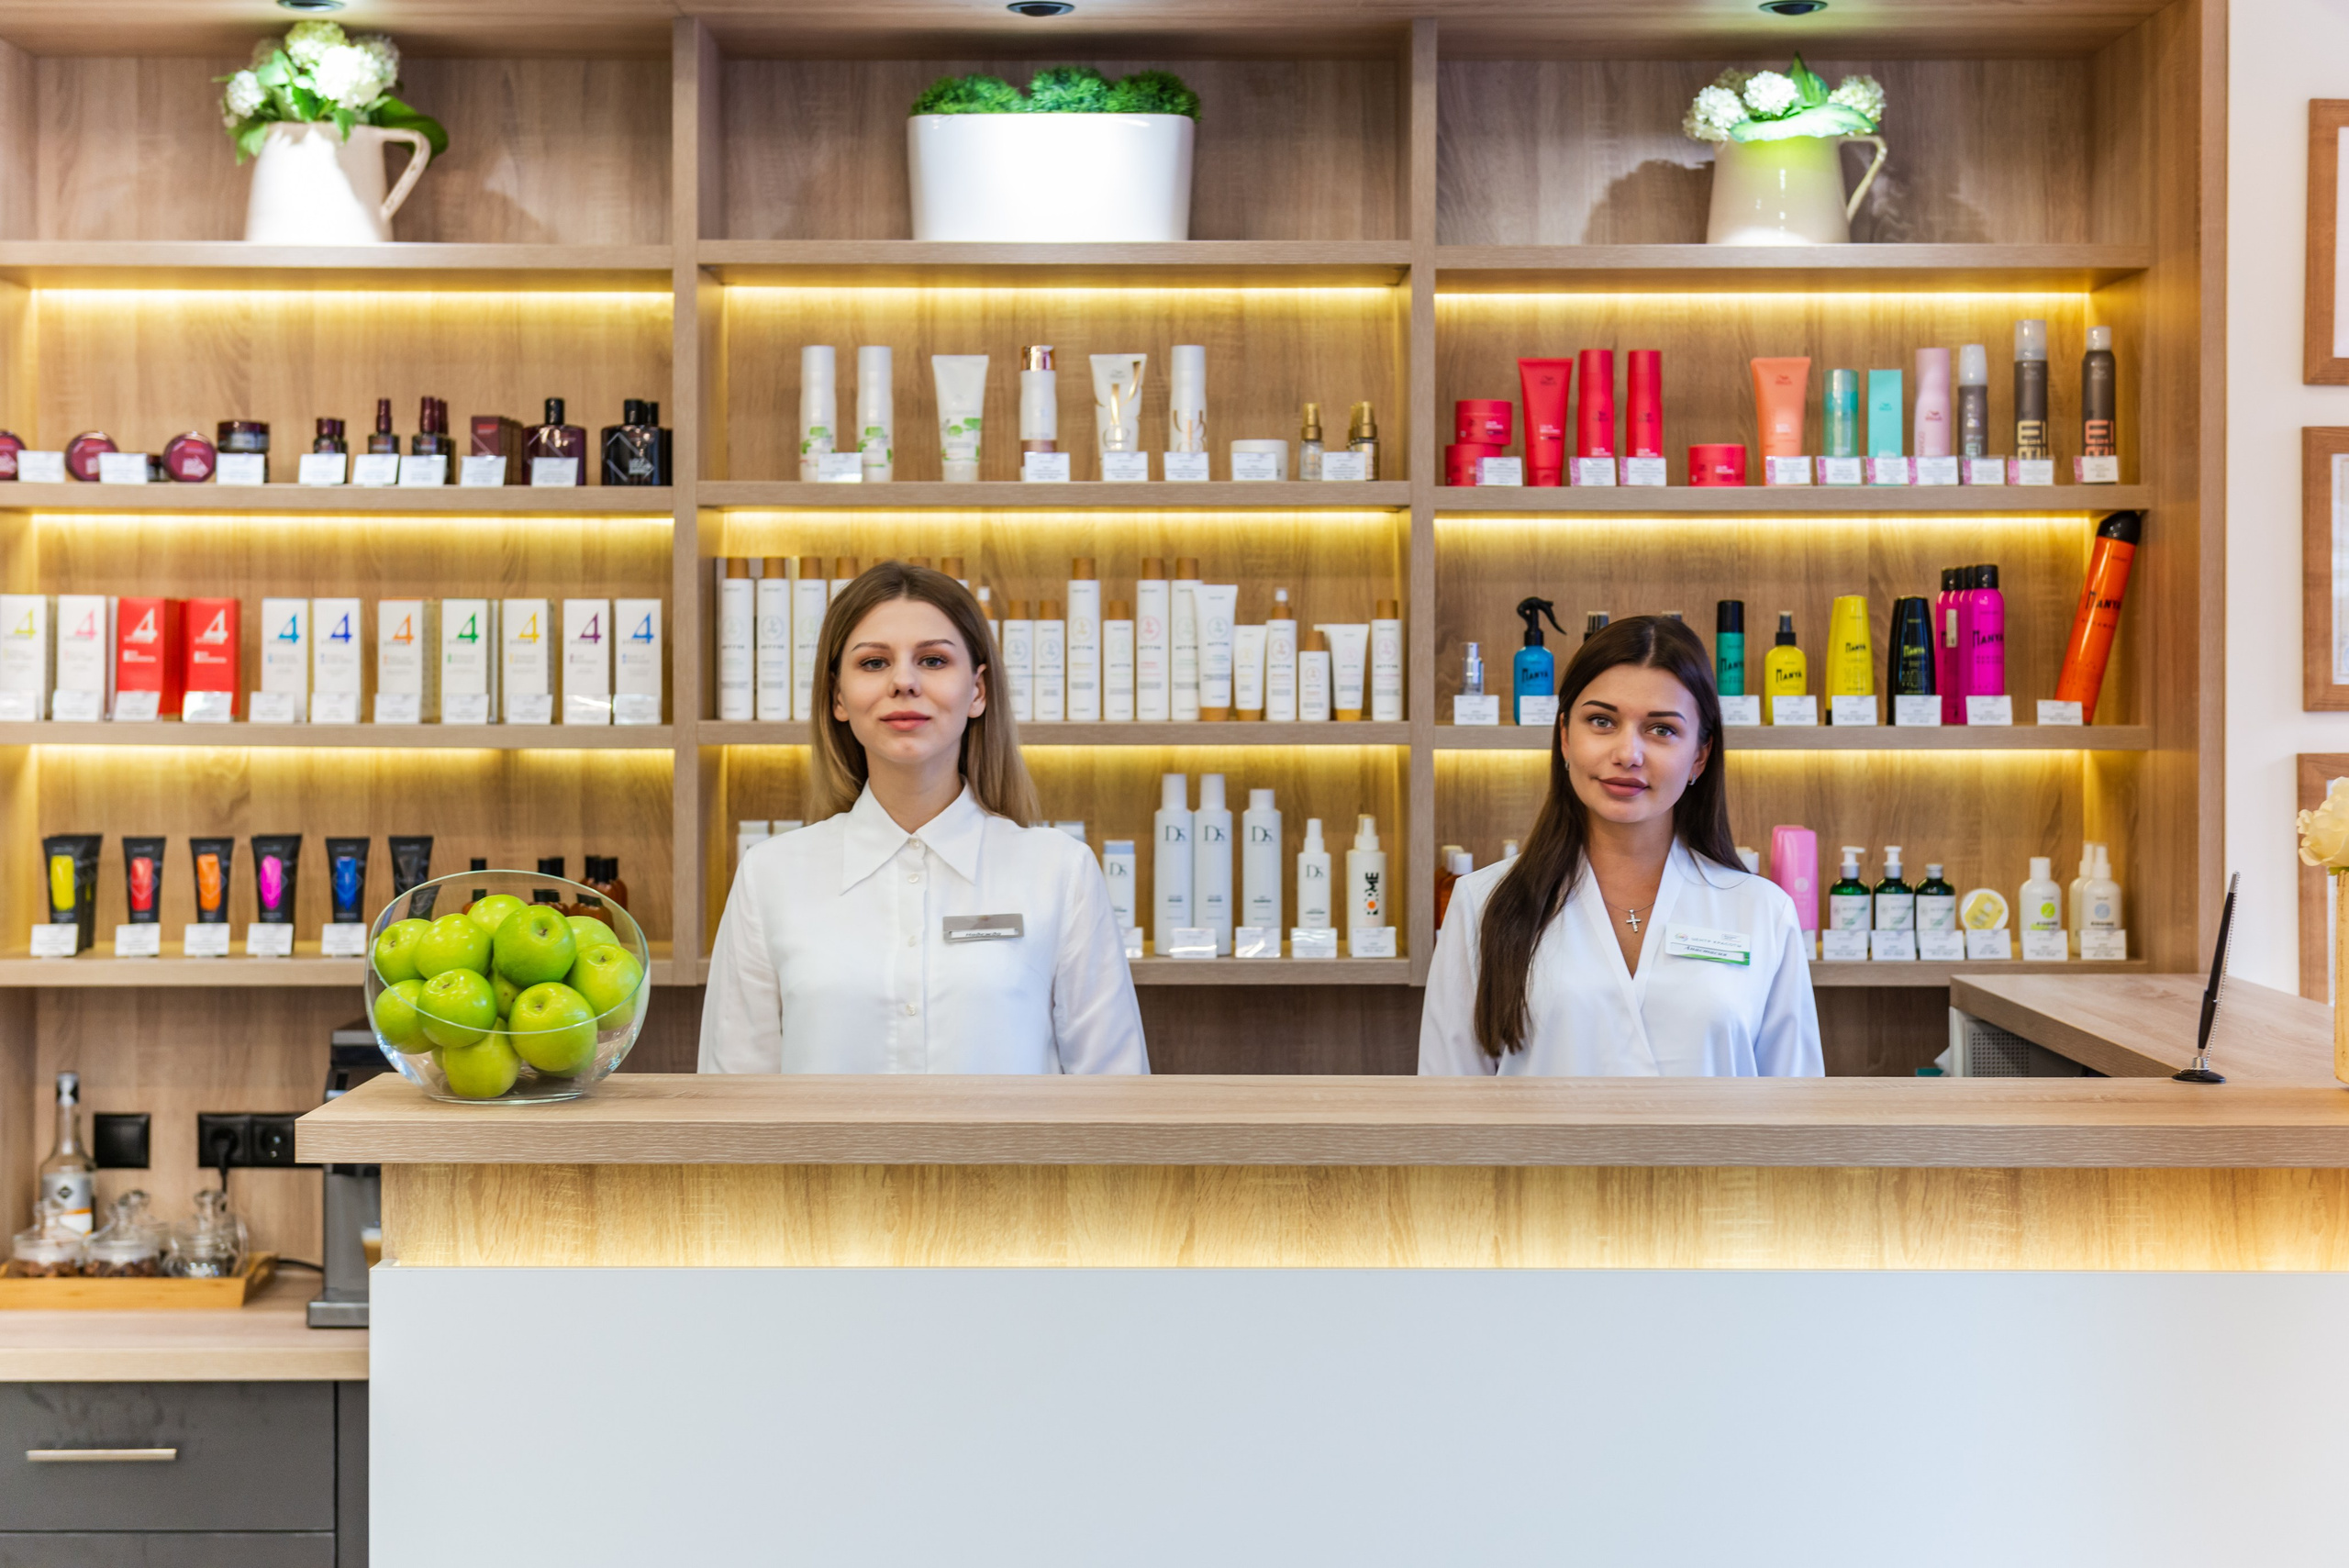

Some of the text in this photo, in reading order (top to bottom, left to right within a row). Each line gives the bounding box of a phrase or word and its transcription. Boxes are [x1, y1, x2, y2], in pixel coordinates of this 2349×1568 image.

[132, 606, 158, 643] 4
[203, 608, 228, 644] 4
[278, 611, 300, 644] 4
[330, 611, 352, 644] 4
[393, 613, 415, 645] 4
[457, 611, 480, 644] 4
[518, 611, 540, 644] 4
[579, 611, 602, 644] 4
[631, 611, 654, 644] 4
